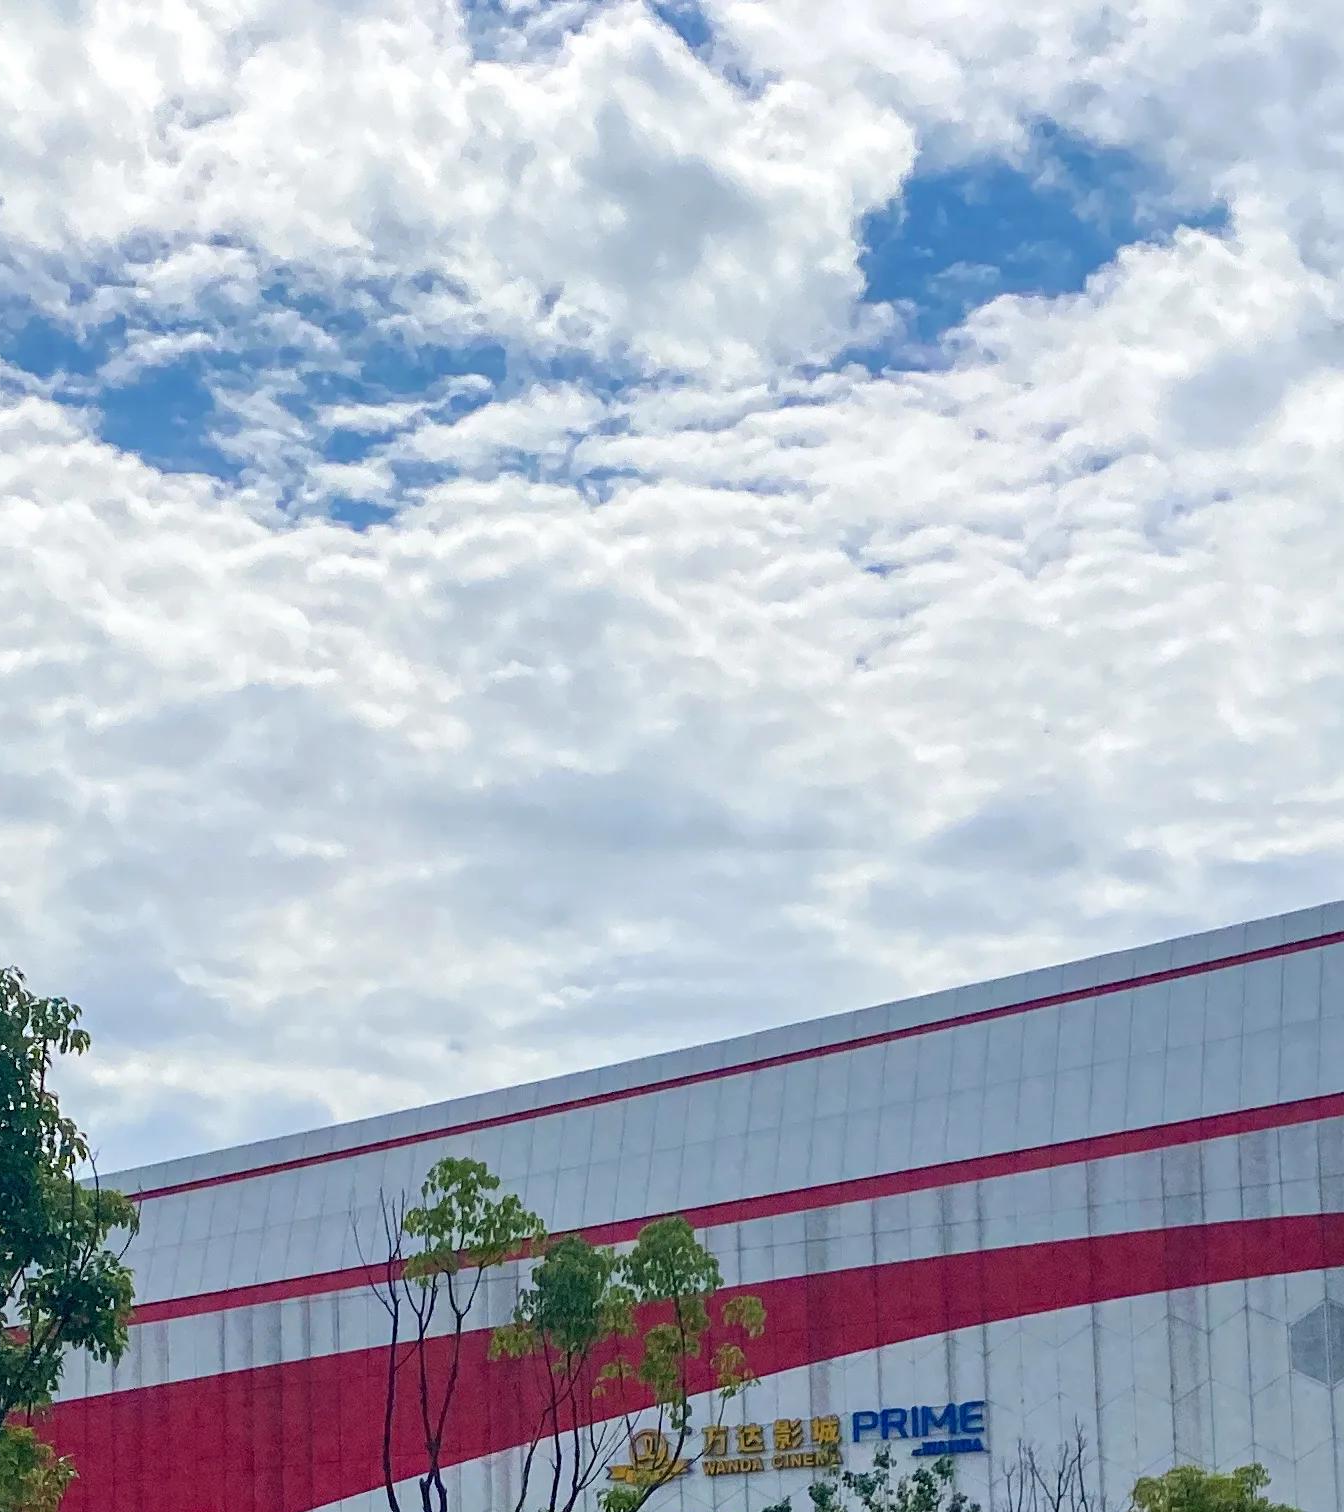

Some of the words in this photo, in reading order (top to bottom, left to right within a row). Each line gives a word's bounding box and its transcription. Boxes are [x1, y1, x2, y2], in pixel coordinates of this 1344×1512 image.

[702, 1414, 842, 1457] 万达影城
[852, 1400, 985, 1442] PRIME
[703, 1457, 765, 1476] WANDA
